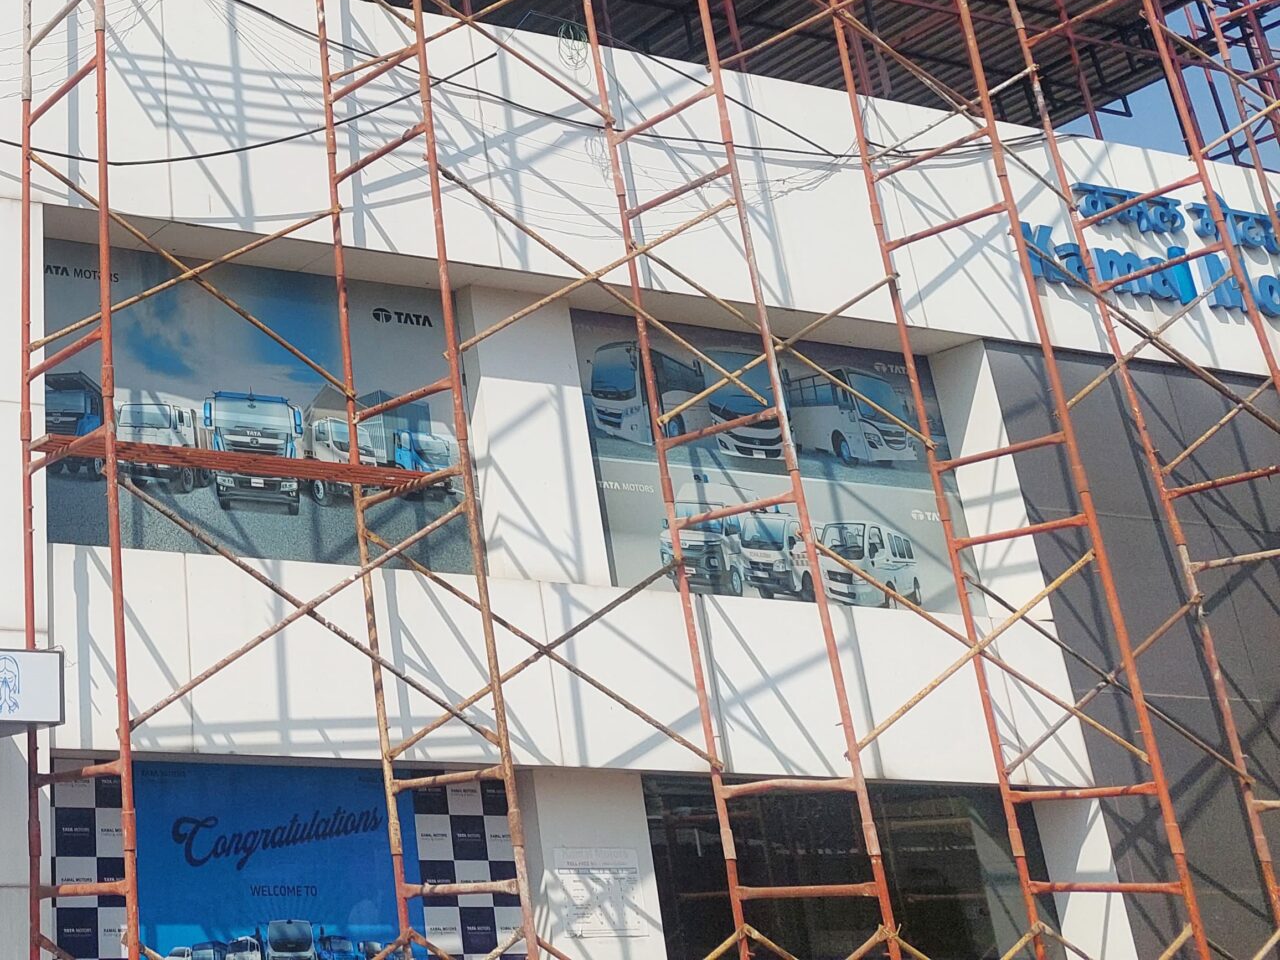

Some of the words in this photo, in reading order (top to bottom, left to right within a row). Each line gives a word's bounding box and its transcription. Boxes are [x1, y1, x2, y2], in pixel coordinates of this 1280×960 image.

[43, 264, 70, 277] ATA
[73, 268, 119, 283] MOTS
[394, 311, 433, 327] TATA
[622, 483, 654, 493] MOTORS
[172, 806, 384, 870] Congratulations
[250, 885, 302, 897] WELCOME
[303, 886, 318, 897] TO
